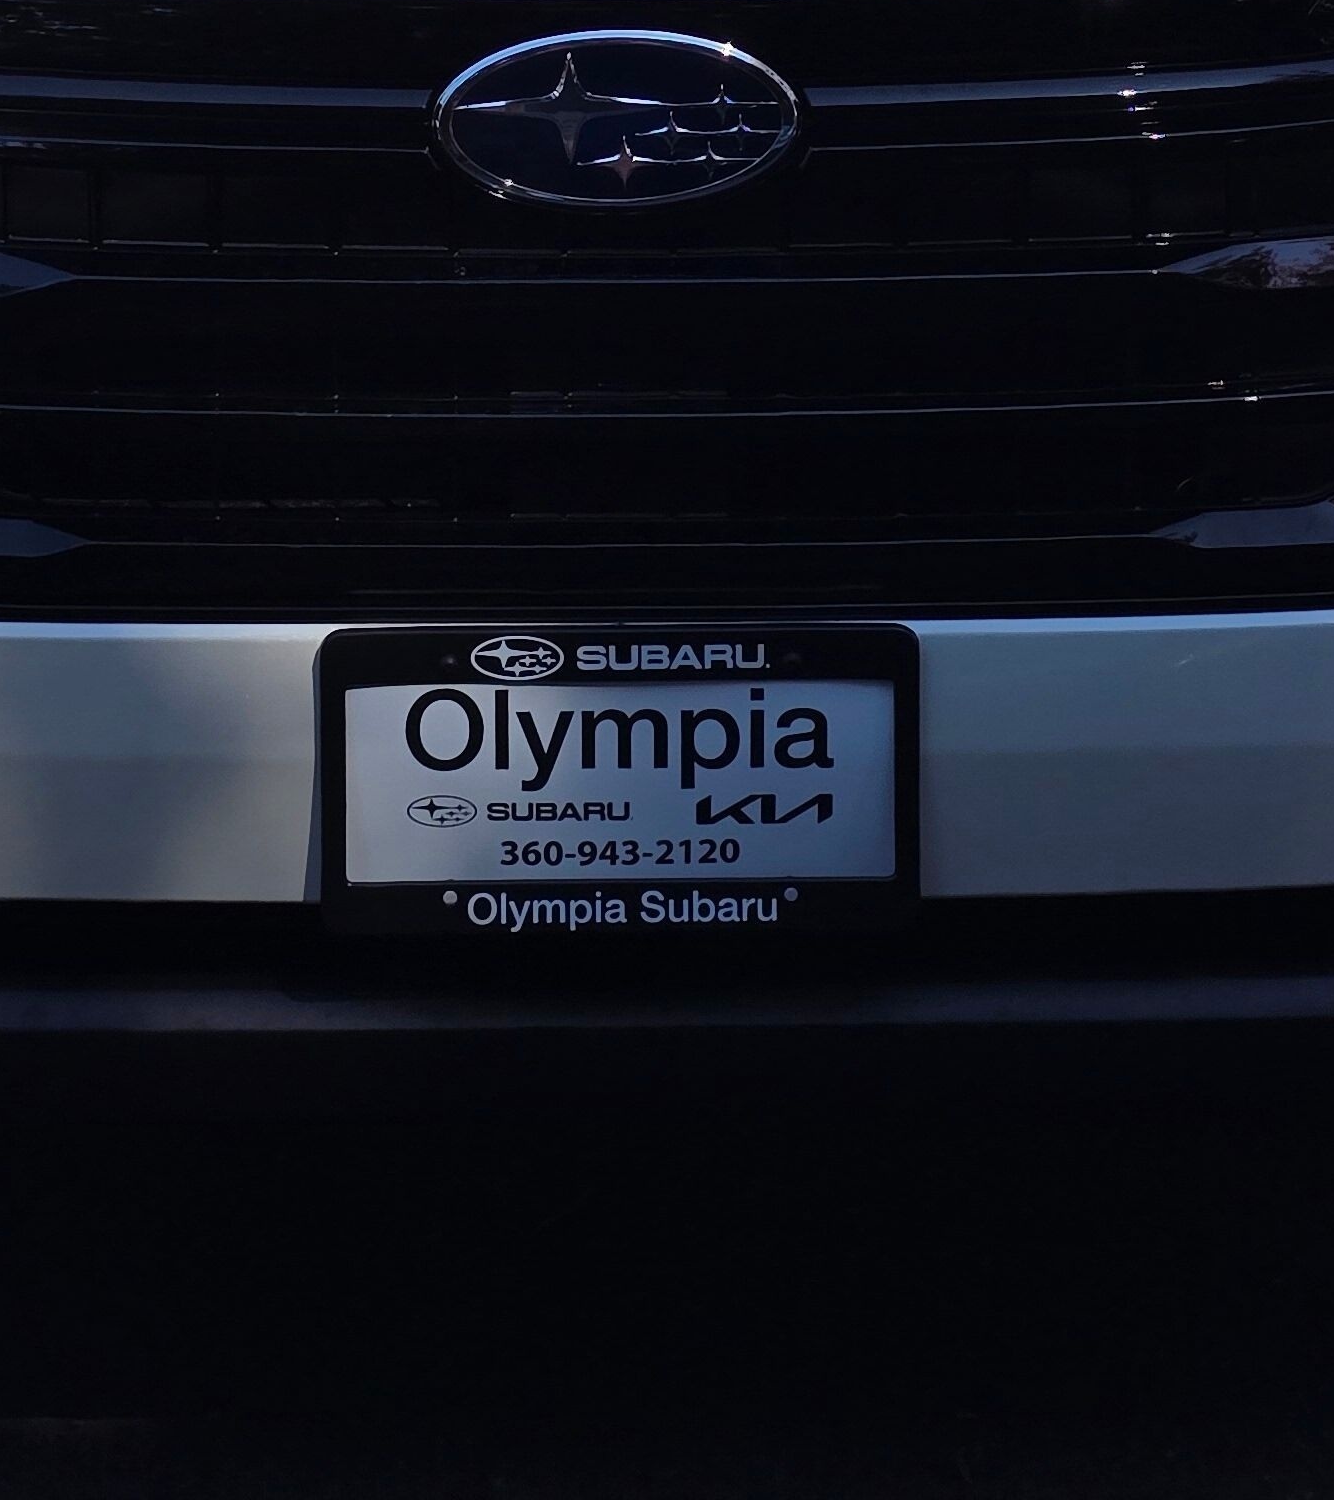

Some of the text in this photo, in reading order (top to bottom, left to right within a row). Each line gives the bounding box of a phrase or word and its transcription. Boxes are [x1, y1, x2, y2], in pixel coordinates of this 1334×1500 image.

[576, 643, 765, 671] SUBARU
[405, 687, 835, 792] Olympia
[486, 801, 631, 822] SUBARU
[695, 793, 834, 825] KIA
[500, 838, 741, 866] 360-943-2120
[467, 889, 778, 933] Olympia Subaru
